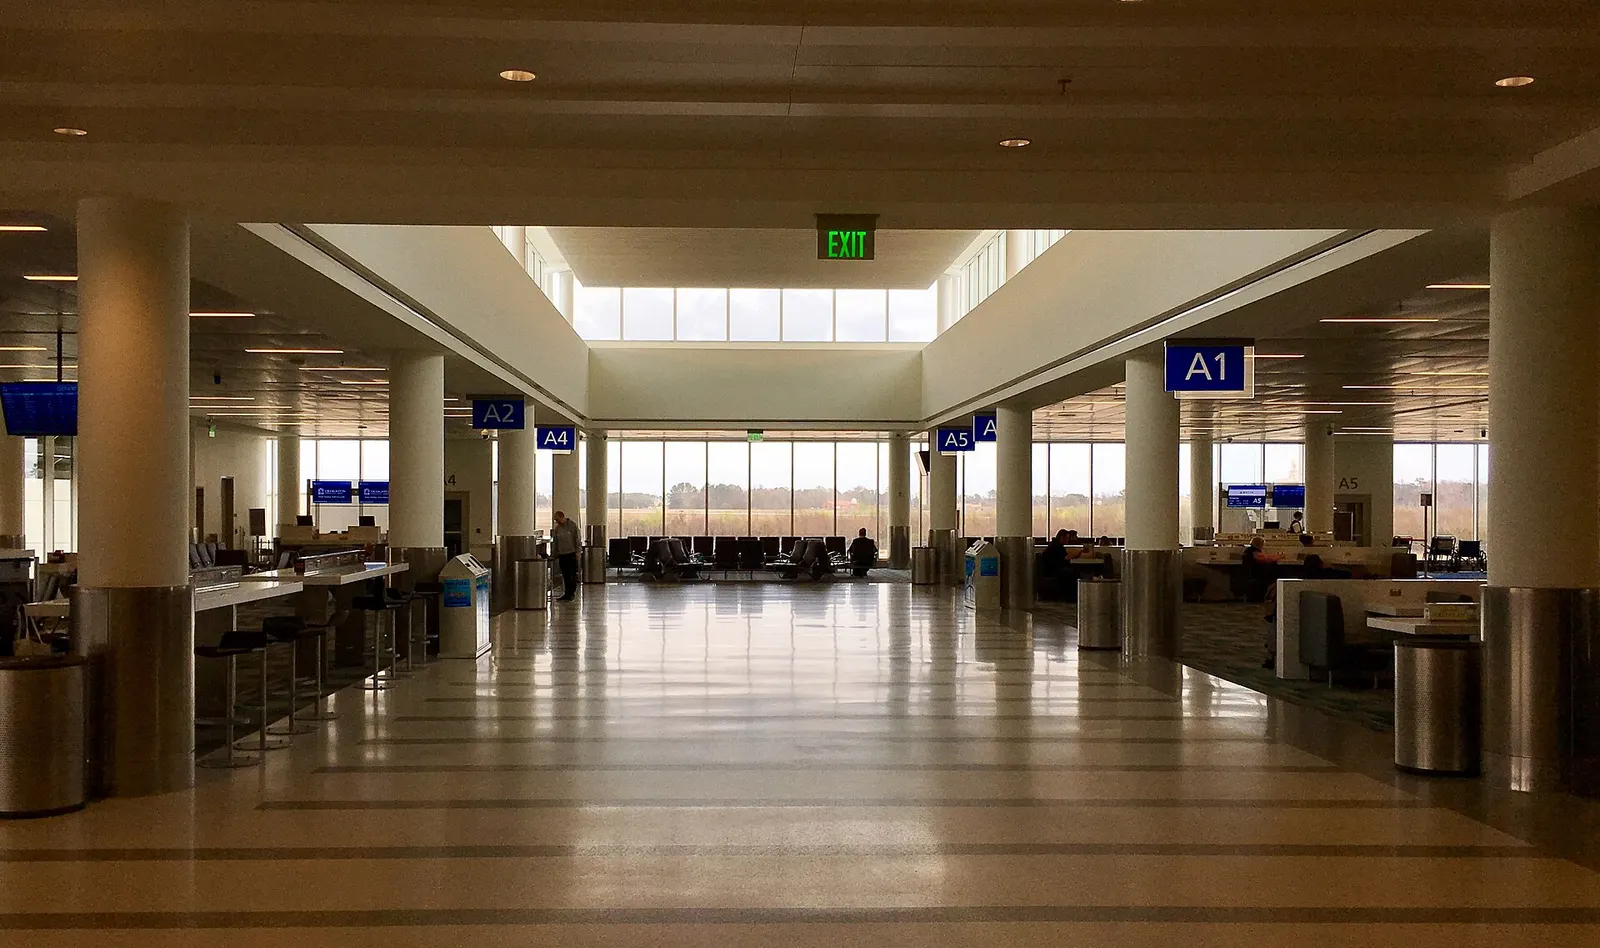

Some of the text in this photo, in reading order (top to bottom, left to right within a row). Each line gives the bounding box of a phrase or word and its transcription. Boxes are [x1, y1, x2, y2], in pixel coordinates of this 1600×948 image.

[829, 231, 866, 257] EXIT
[1185, 352, 1225, 380] A1
[483, 404, 514, 422] A2
[983, 419, 997, 435] A
[544, 431, 568, 445] A4
[945, 432, 968, 446] A5
[444, 474, 456, 486] 4
[1338, 477, 1358, 490] A5
